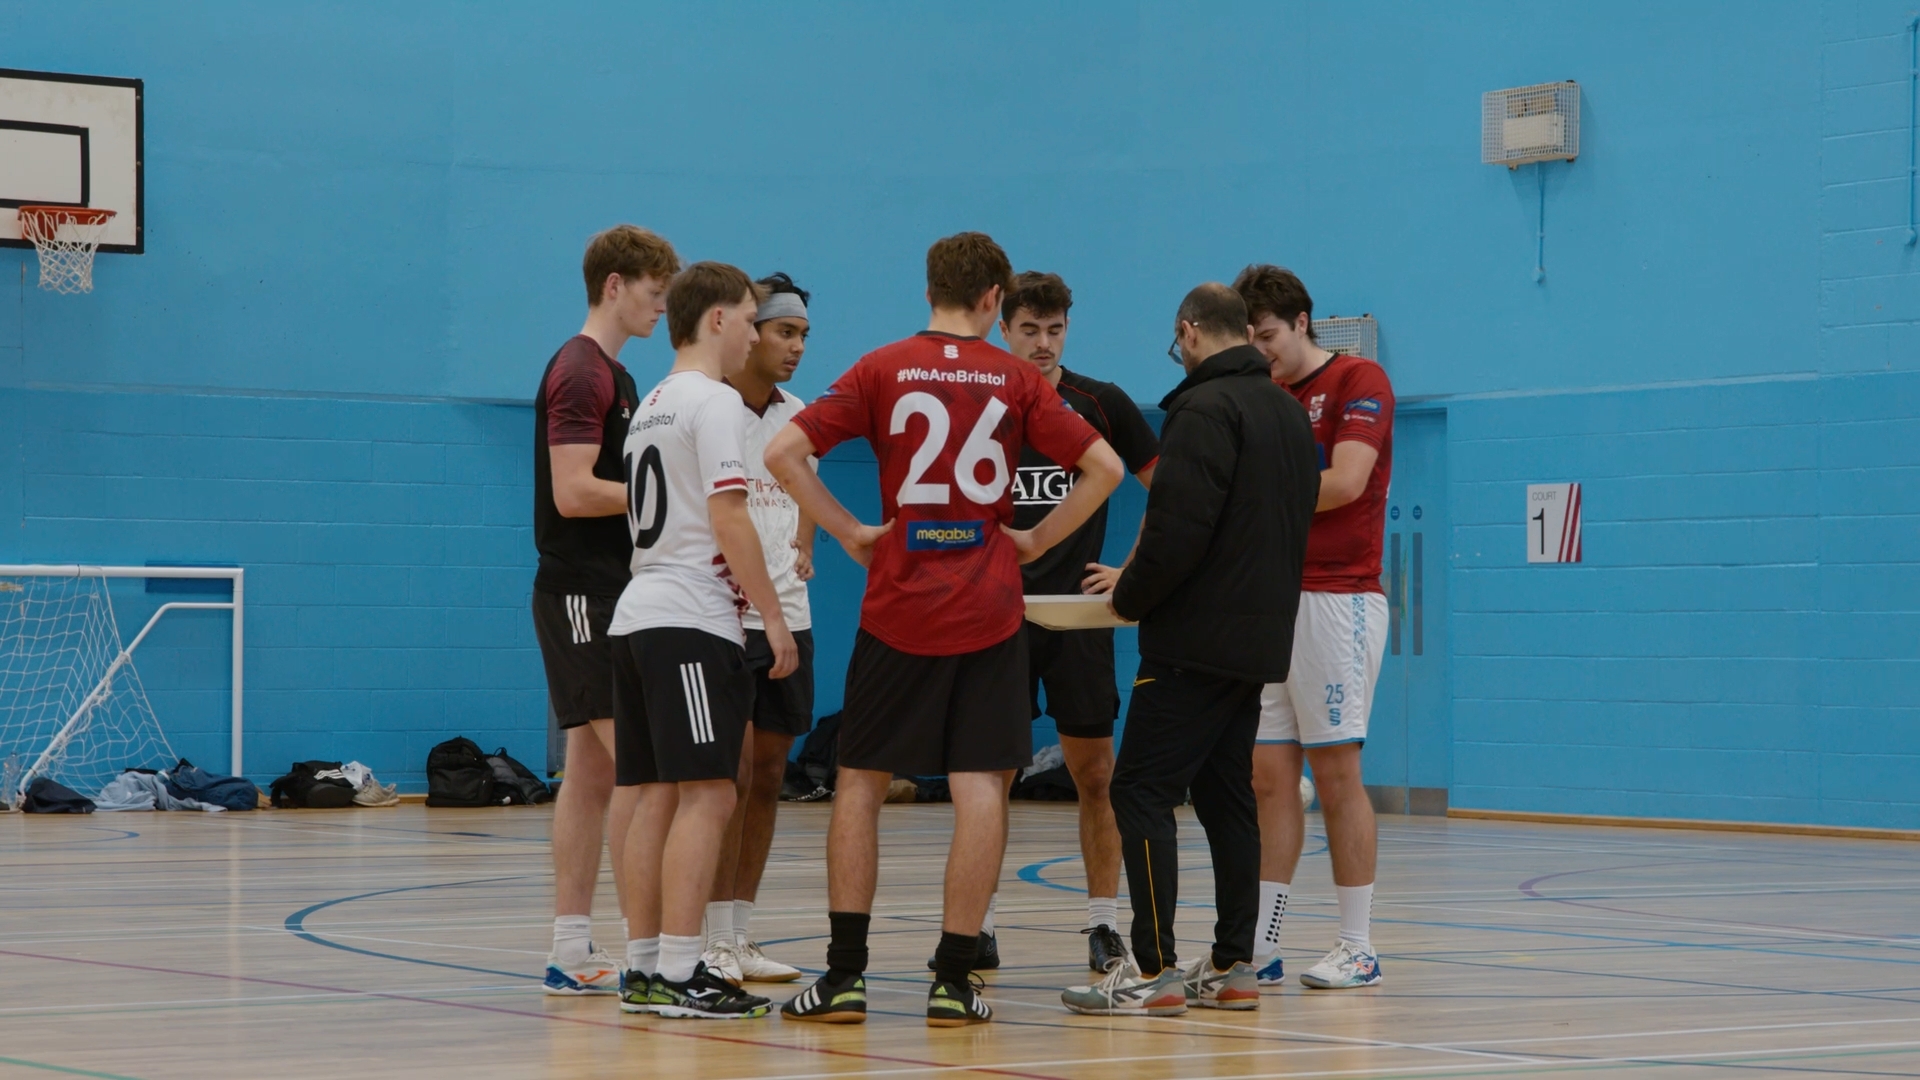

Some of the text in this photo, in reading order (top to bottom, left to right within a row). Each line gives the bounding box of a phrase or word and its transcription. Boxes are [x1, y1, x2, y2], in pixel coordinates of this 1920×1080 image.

[897, 367, 1006, 387] #WeAreBristol
[630, 412, 677, 436] eAreBristol
[889, 391, 1010, 507] 26
[1011, 471, 1069, 500] AIG
[1532, 491, 1557, 501] COURT
[916, 527, 976, 543] megabus
[1532, 507, 1545, 555] 1
[1325, 684, 1345, 705] 25
